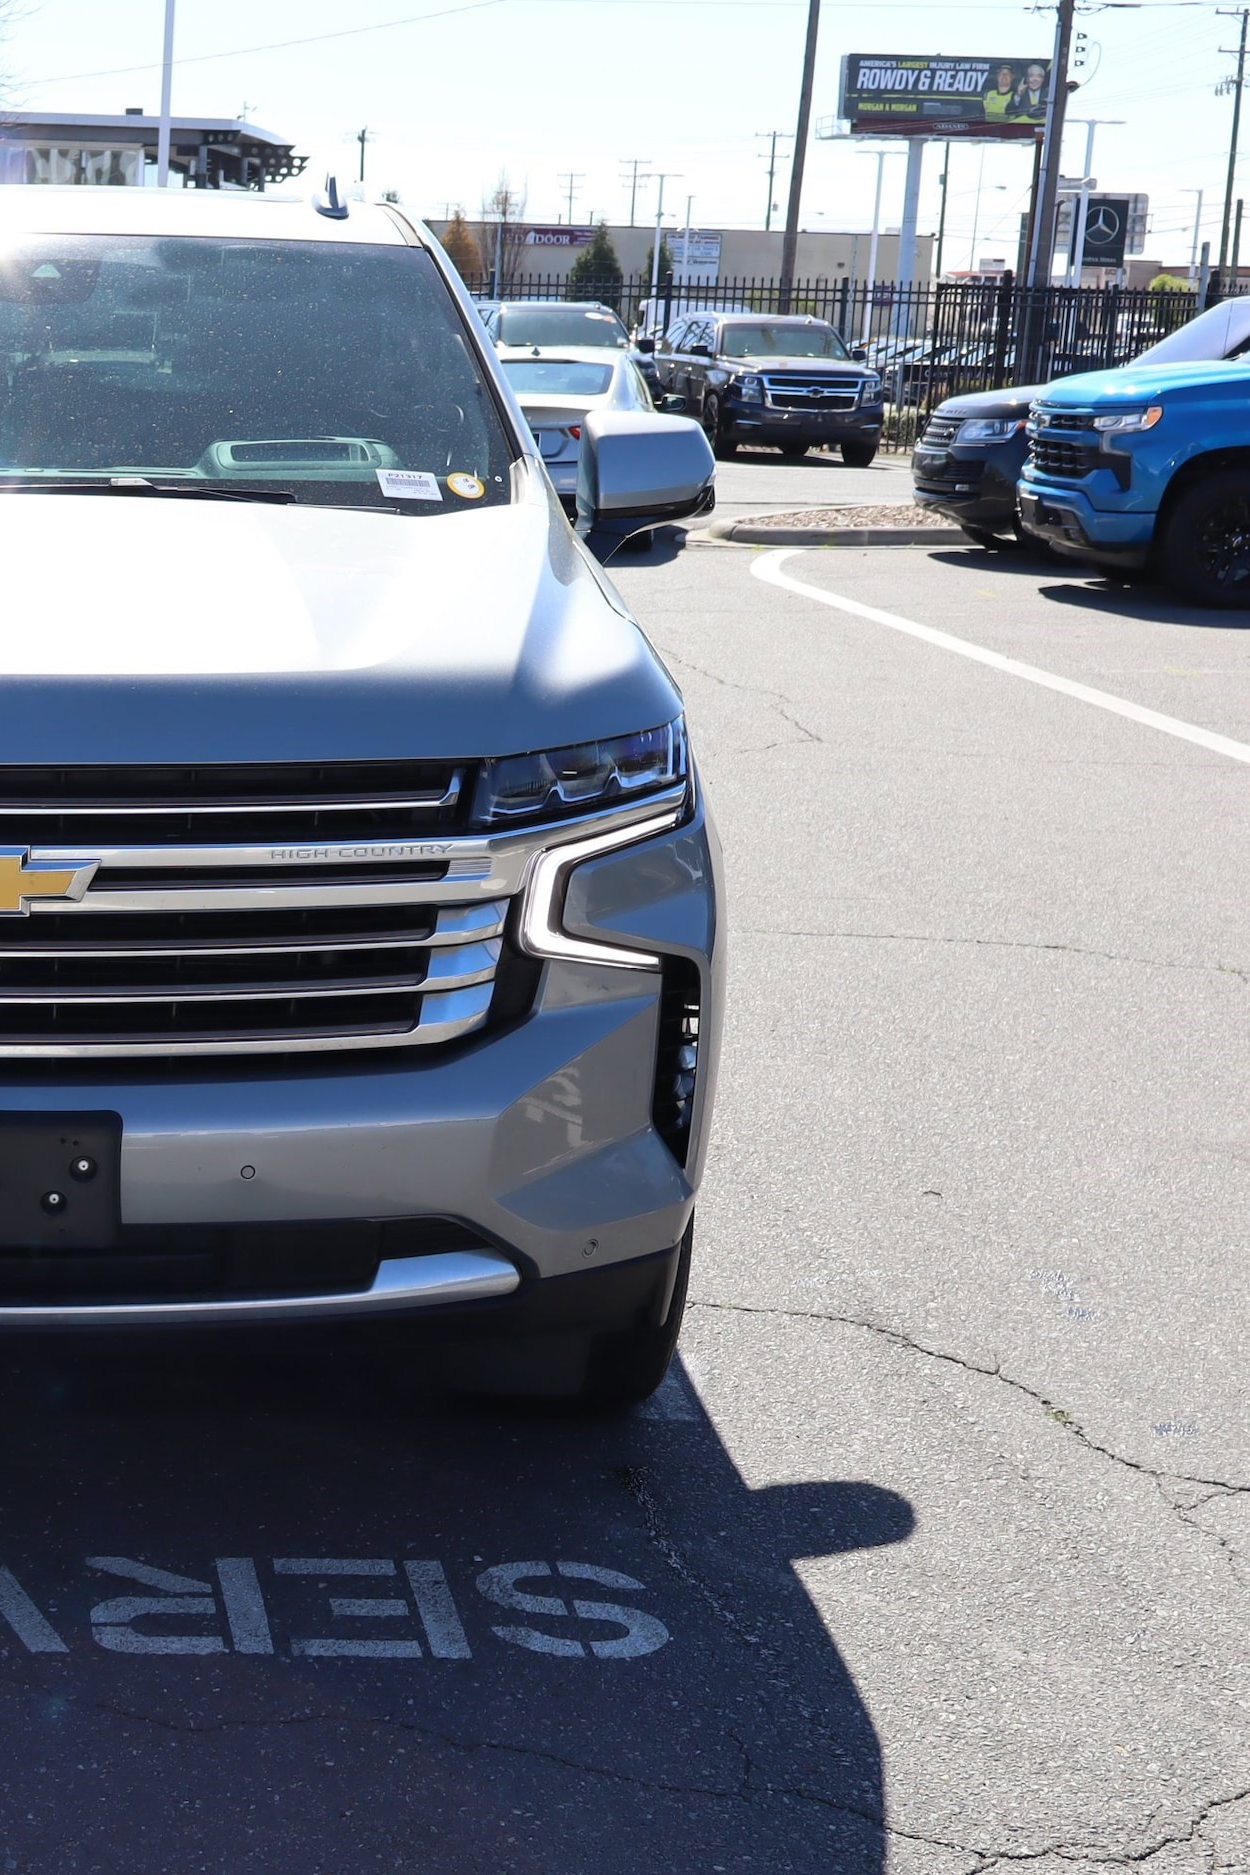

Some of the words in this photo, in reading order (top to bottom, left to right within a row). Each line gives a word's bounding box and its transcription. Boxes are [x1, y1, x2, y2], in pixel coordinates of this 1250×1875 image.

[929, 61, 955, 70] INJURY
[956, 62, 971, 70] LAW
[972, 62, 990, 71] FIRM
[857, 69, 918, 90] ROWDY
[918, 69, 931, 91] &
[933, 70, 989, 92] READY
[858, 102, 884, 111] MORGAN
[891, 103, 917, 112] MORGAN
[535, 233, 570, 245] DOOR
[271, 848, 328, 860] HIGH
[339, 843, 454, 858] COUNTRY
